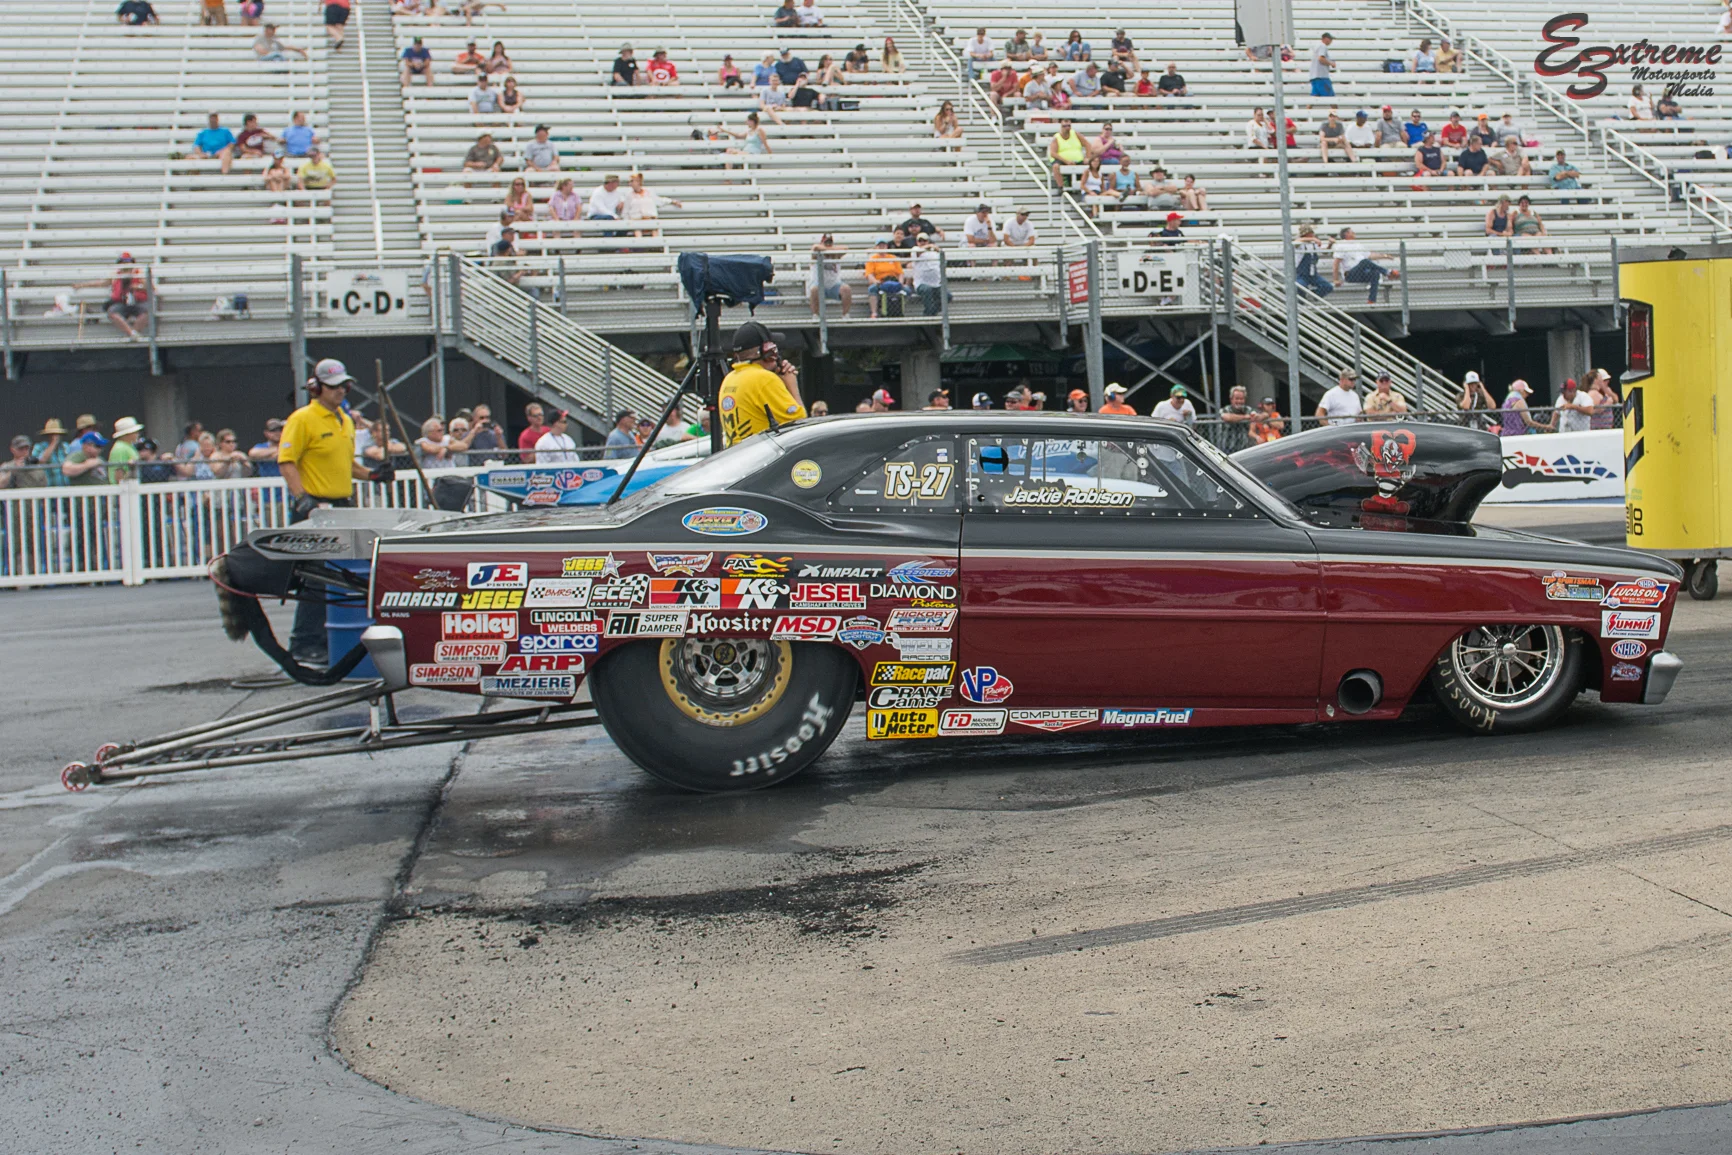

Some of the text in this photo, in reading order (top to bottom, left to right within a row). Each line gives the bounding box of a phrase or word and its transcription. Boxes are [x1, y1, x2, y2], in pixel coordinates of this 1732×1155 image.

[885, 463, 953, 498] TS-27
[1004, 487, 1133, 507] Jackie Robison
[565, 558, 604, 570] JEGS
[722, 558, 759, 570] PAC
[413, 568, 451, 582] Super
[471, 564, 521, 586] JE
[1557, 577, 1597, 585] SPORTSMAN
[419, 577, 460, 591] Sport
[1638, 580, 1656, 588] NHRA
[592, 586, 634, 600] SCE
[791, 585, 863, 601] JESEL
[870, 584, 957, 600] DIAMOND
[1613, 588, 1643, 596] LUCAS
[1644, 589, 1659, 598] OIL
[380, 592, 458, 607] MOROSO
[461, 590, 525, 609] JEGS
[911, 599, 957, 609] Pistons
[534, 612, 591, 622] LINCOLN
[608, 613, 641, 635] ATI
[645, 614, 678, 622] SUPER
[686, 612, 772, 634] Hoosier
[444, 613, 518, 639] Holley
[548, 624, 597, 633] WELDERS
[776, 617, 837, 633] MSD
[520, 635, 597, 651] sparco
[901, 639, 951, 651] WELD
[1617, 642, 1641, 656] NHRA
[440, 645, 500, 657] SIMPSON
[501, 656, 582, 671] ARP
[416, 667, 475, 678] SIMPSON
[892, 664, 949, 683] Racepak
[496, 677, 571, 688] MEZIERE
[963, 667, 997, 702] VP
[1438, 657, 1500, 730] Hoosier
[889, 712, 927, 722] Auto
[948, 713, 972, 727] T&D
[1011, 710, 1097, 719] COMPUTECH
[1102, 710, 1191, 727] MagnaFuel
[730, 692, 834, 776] Hoosier
[885, 723, 935, 736] Meter
